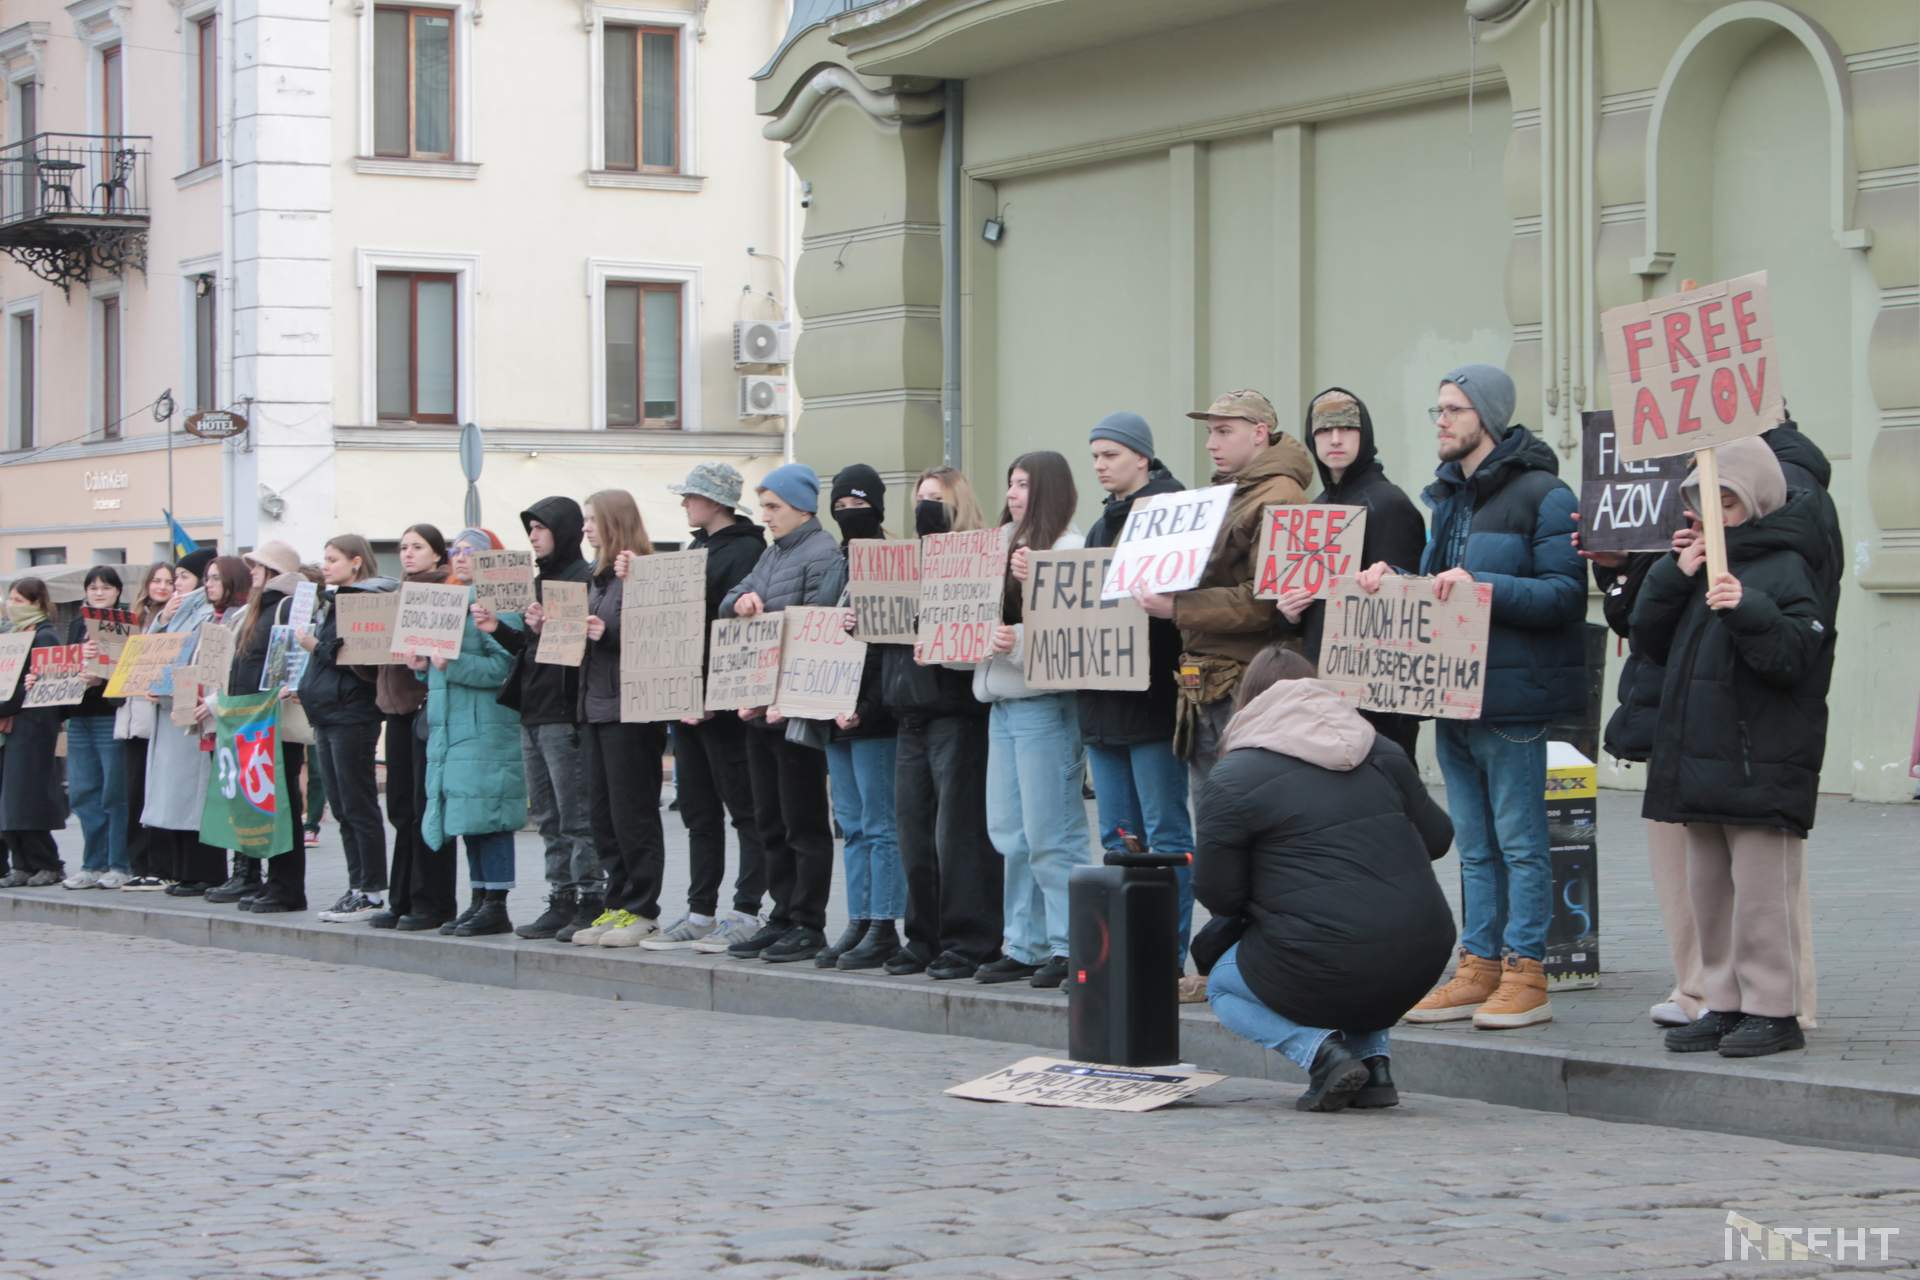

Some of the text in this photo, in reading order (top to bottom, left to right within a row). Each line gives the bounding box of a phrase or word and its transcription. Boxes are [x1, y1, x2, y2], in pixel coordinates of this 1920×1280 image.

[1622, 290, 1763, 384] FREE
[1632, 356, 1767, 446] AZOV
[197, 420, 238, 432] HOTEL
[1123, 500, 1214, 544] FREE
[1592, 480, 1669, 531] AZOV
[1268, 509, 1348, 554] FREE
[1103, 547, 1211, 596] AZOV
[1259, 553, 1352, 596] AZOV
[717, 619, 740, 647] МІЙ
[746, 620, 780, 643] СТРАХ
[1399, 600, 1433, 644] НЕ
[1027, 625, 1135, 682] МЮНХЕН
